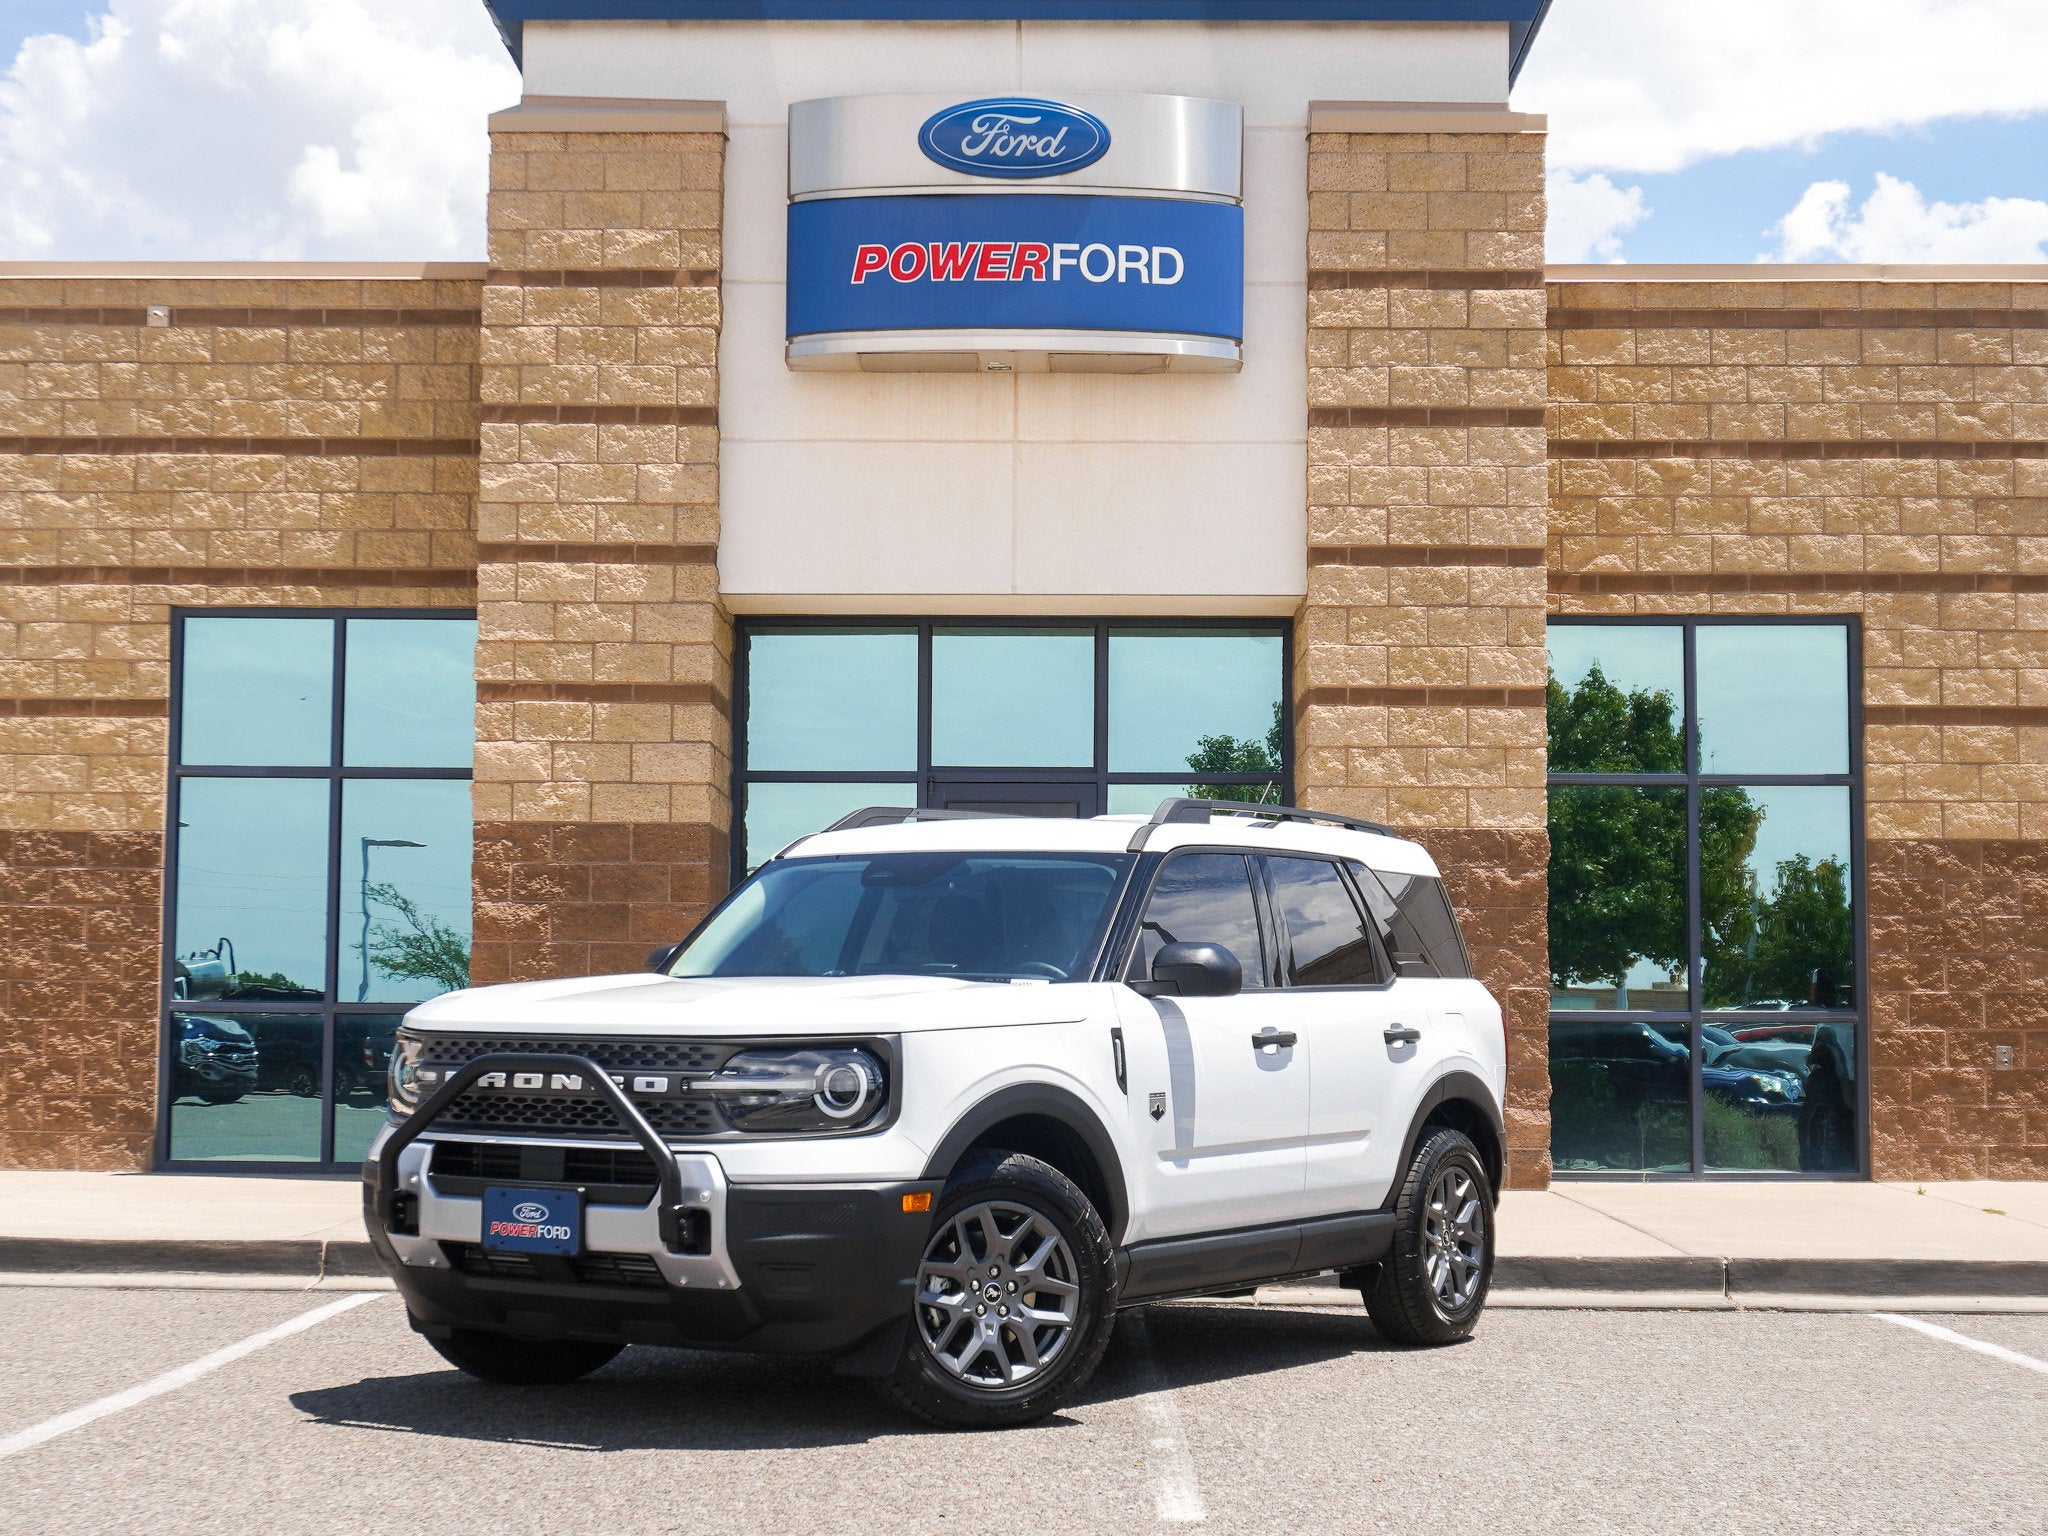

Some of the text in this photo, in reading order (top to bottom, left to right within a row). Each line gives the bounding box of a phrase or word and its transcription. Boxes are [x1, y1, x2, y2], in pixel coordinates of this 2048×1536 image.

[961, 113, 1067, 158] Ford
[445, 1070, 669, 1093] RONO
[519, 1206, 541, 1219] Ford
